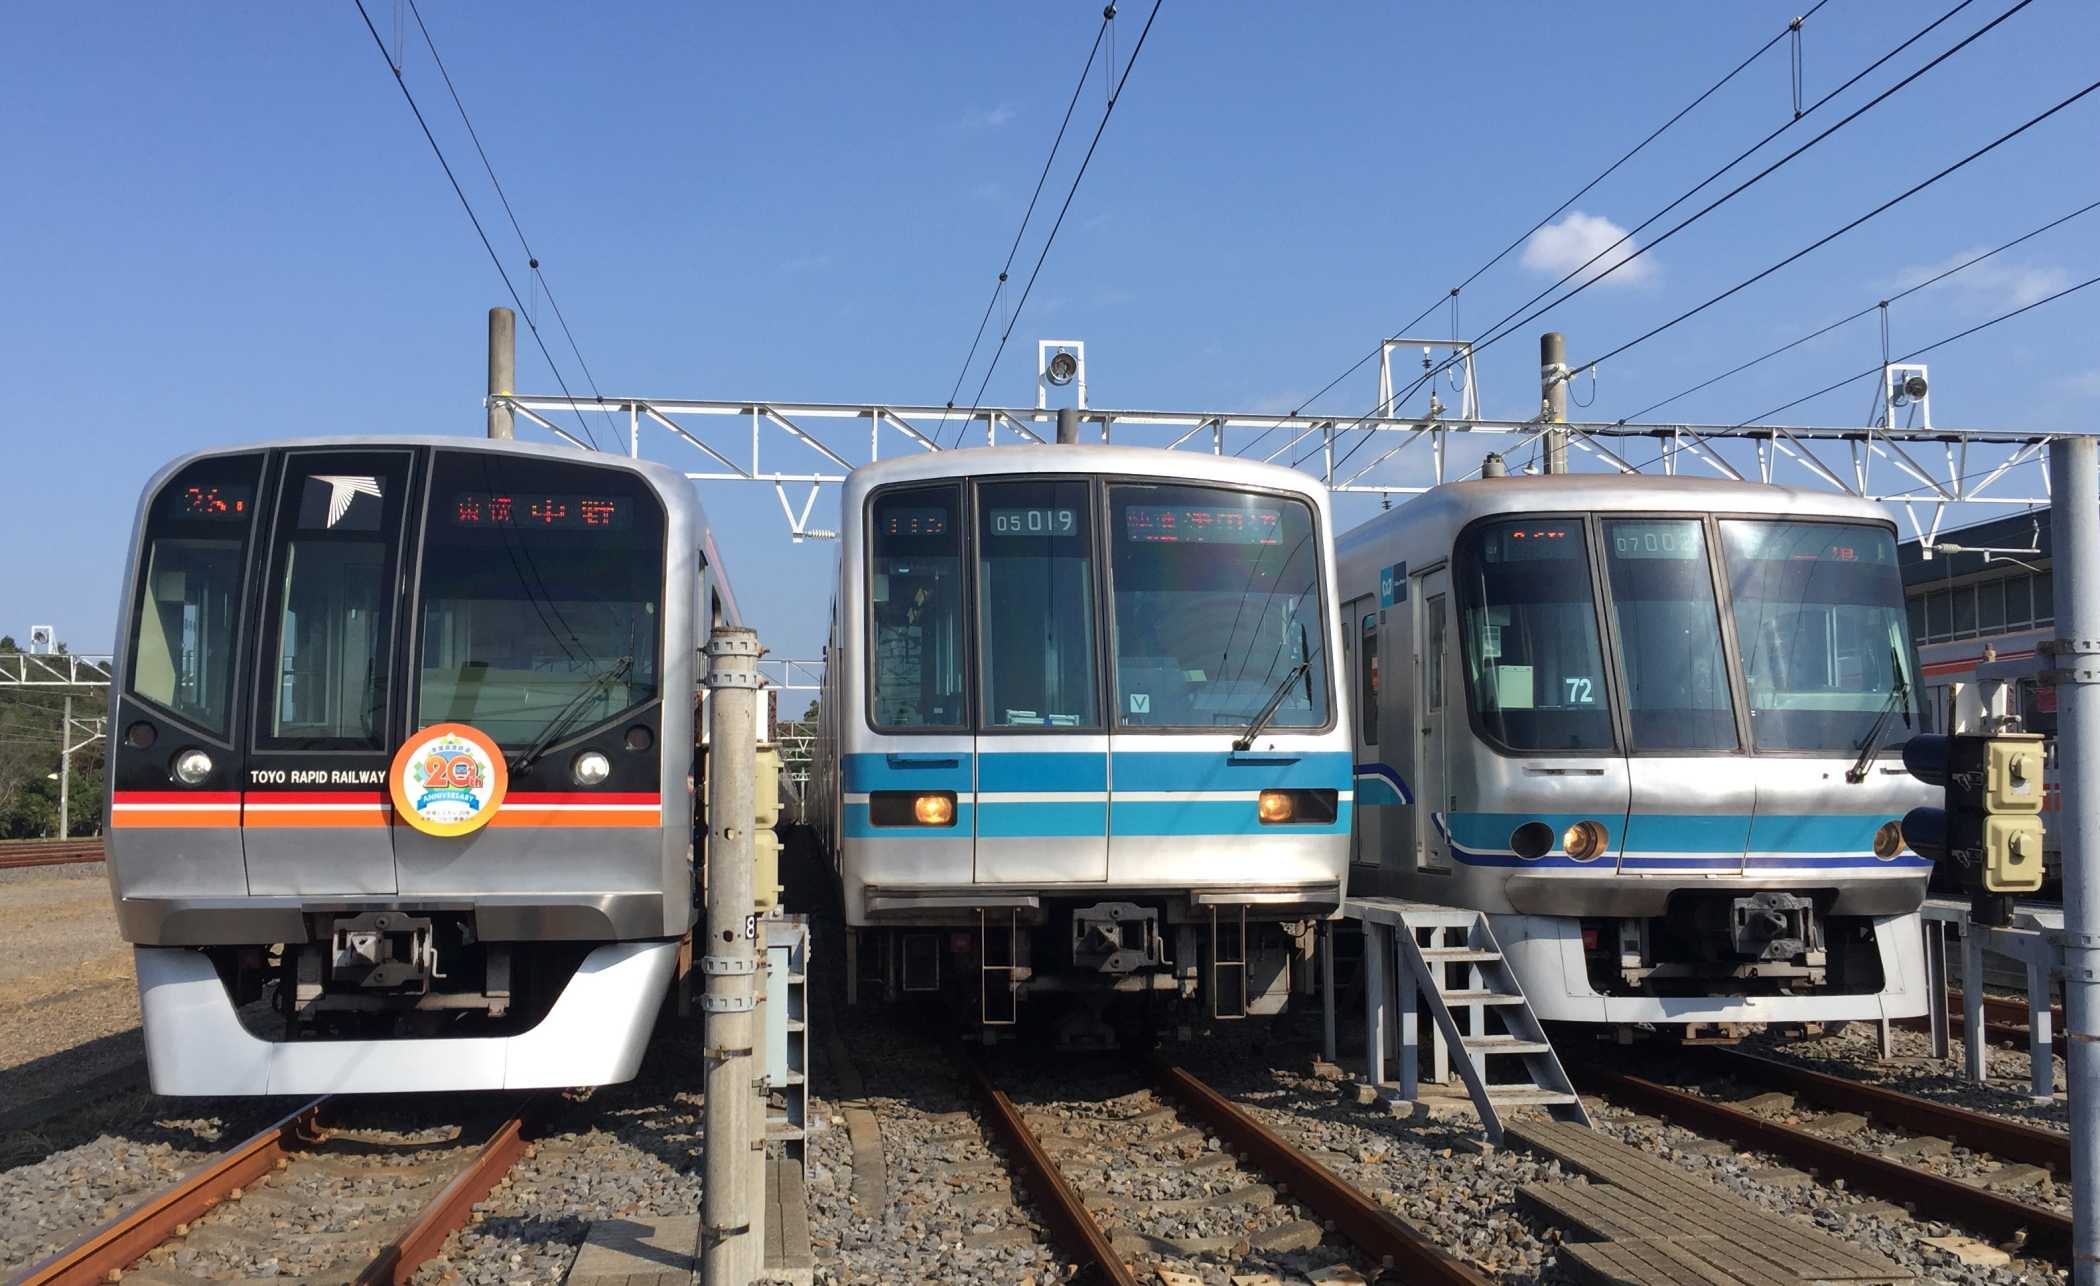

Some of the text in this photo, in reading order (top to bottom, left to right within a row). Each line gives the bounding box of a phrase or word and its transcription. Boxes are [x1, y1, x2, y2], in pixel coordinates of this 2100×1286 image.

[1566, 678, 1593, 702] 72
[250, 770, 386, 783] TOYO RAPID RAILWAY
